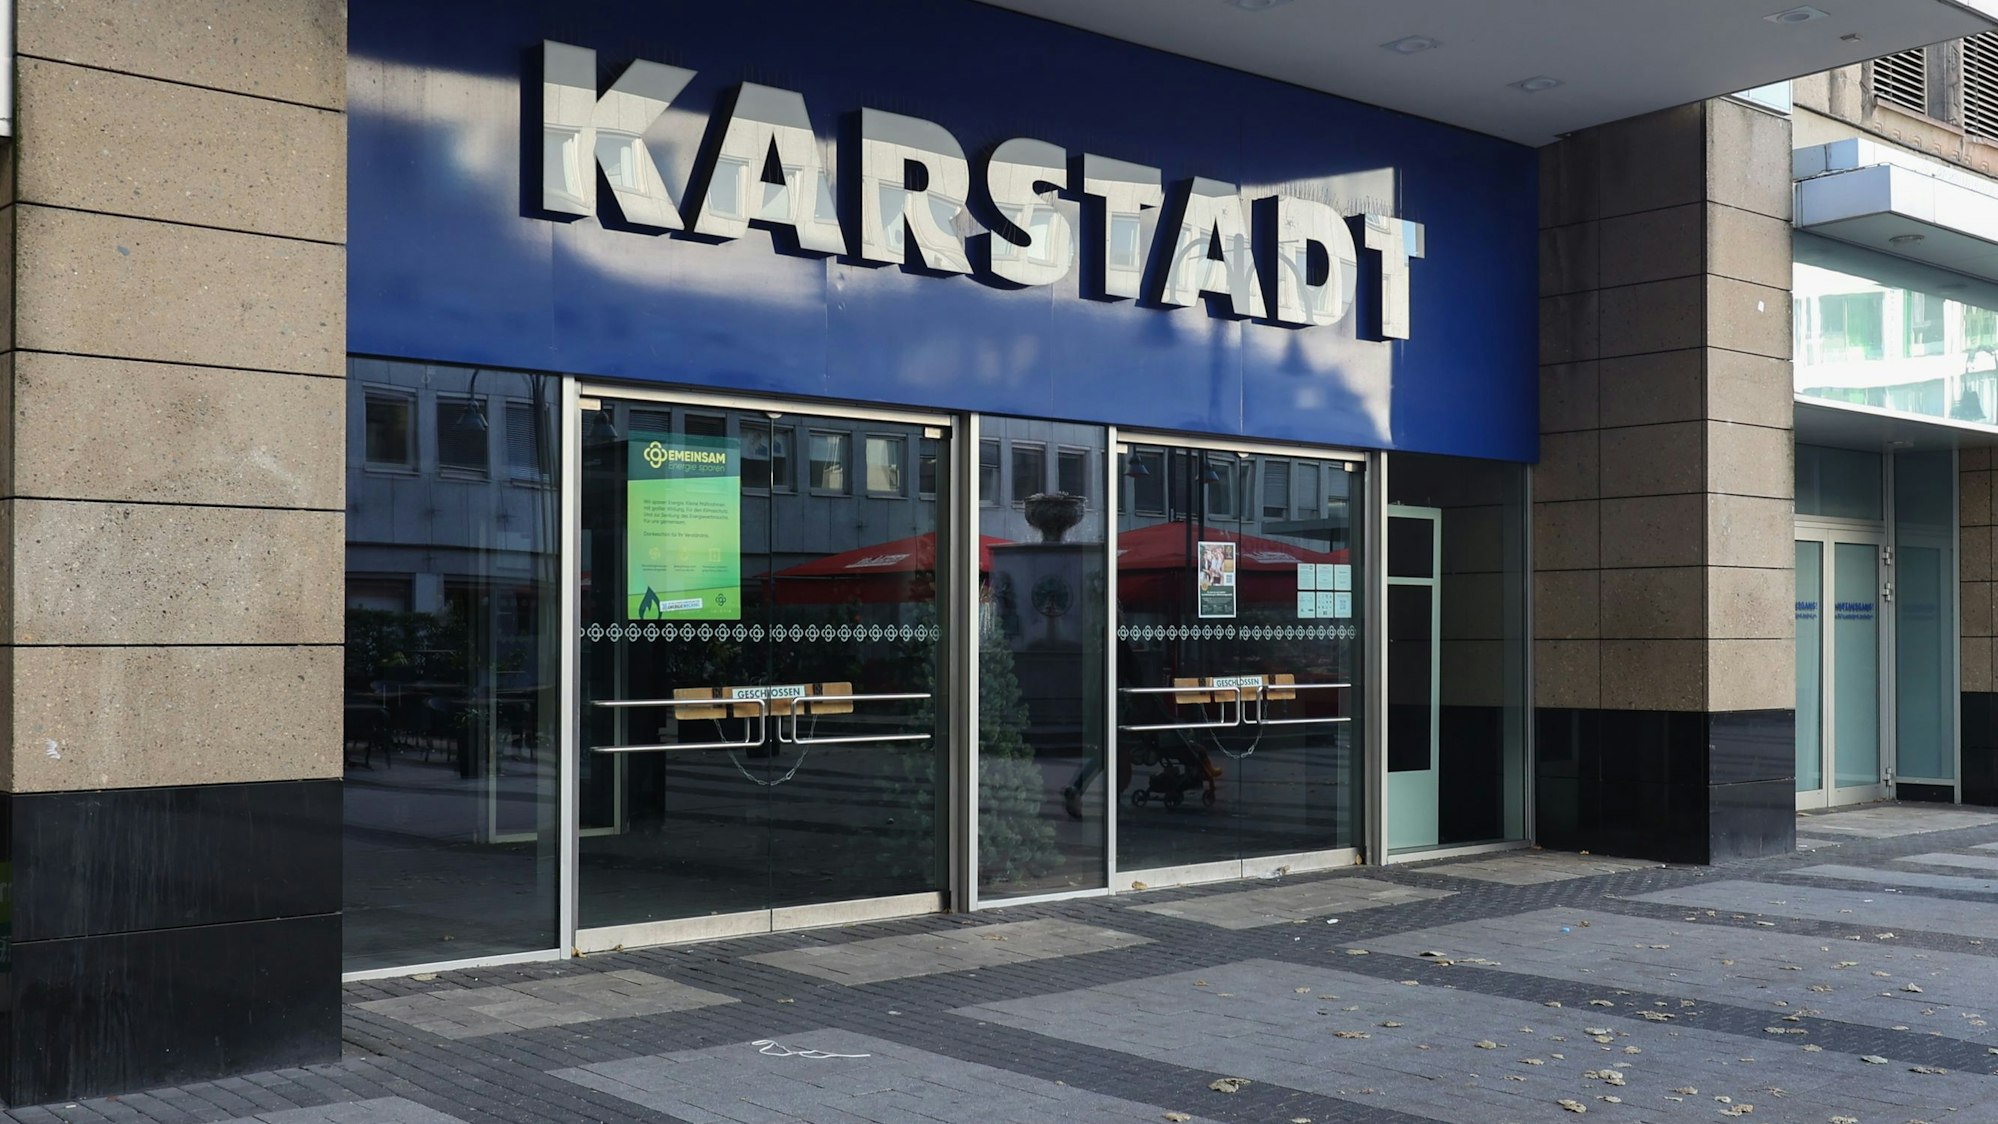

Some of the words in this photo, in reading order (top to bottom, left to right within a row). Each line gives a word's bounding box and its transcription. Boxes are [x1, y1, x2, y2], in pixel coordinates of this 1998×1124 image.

[541, 38, 1425, 341] KARSTADT
[668, 462, 697, 472] Energie
[698, 464, 725, 473] sparen
[1216, 678, 1259, 688] GESCHLOSSEN
